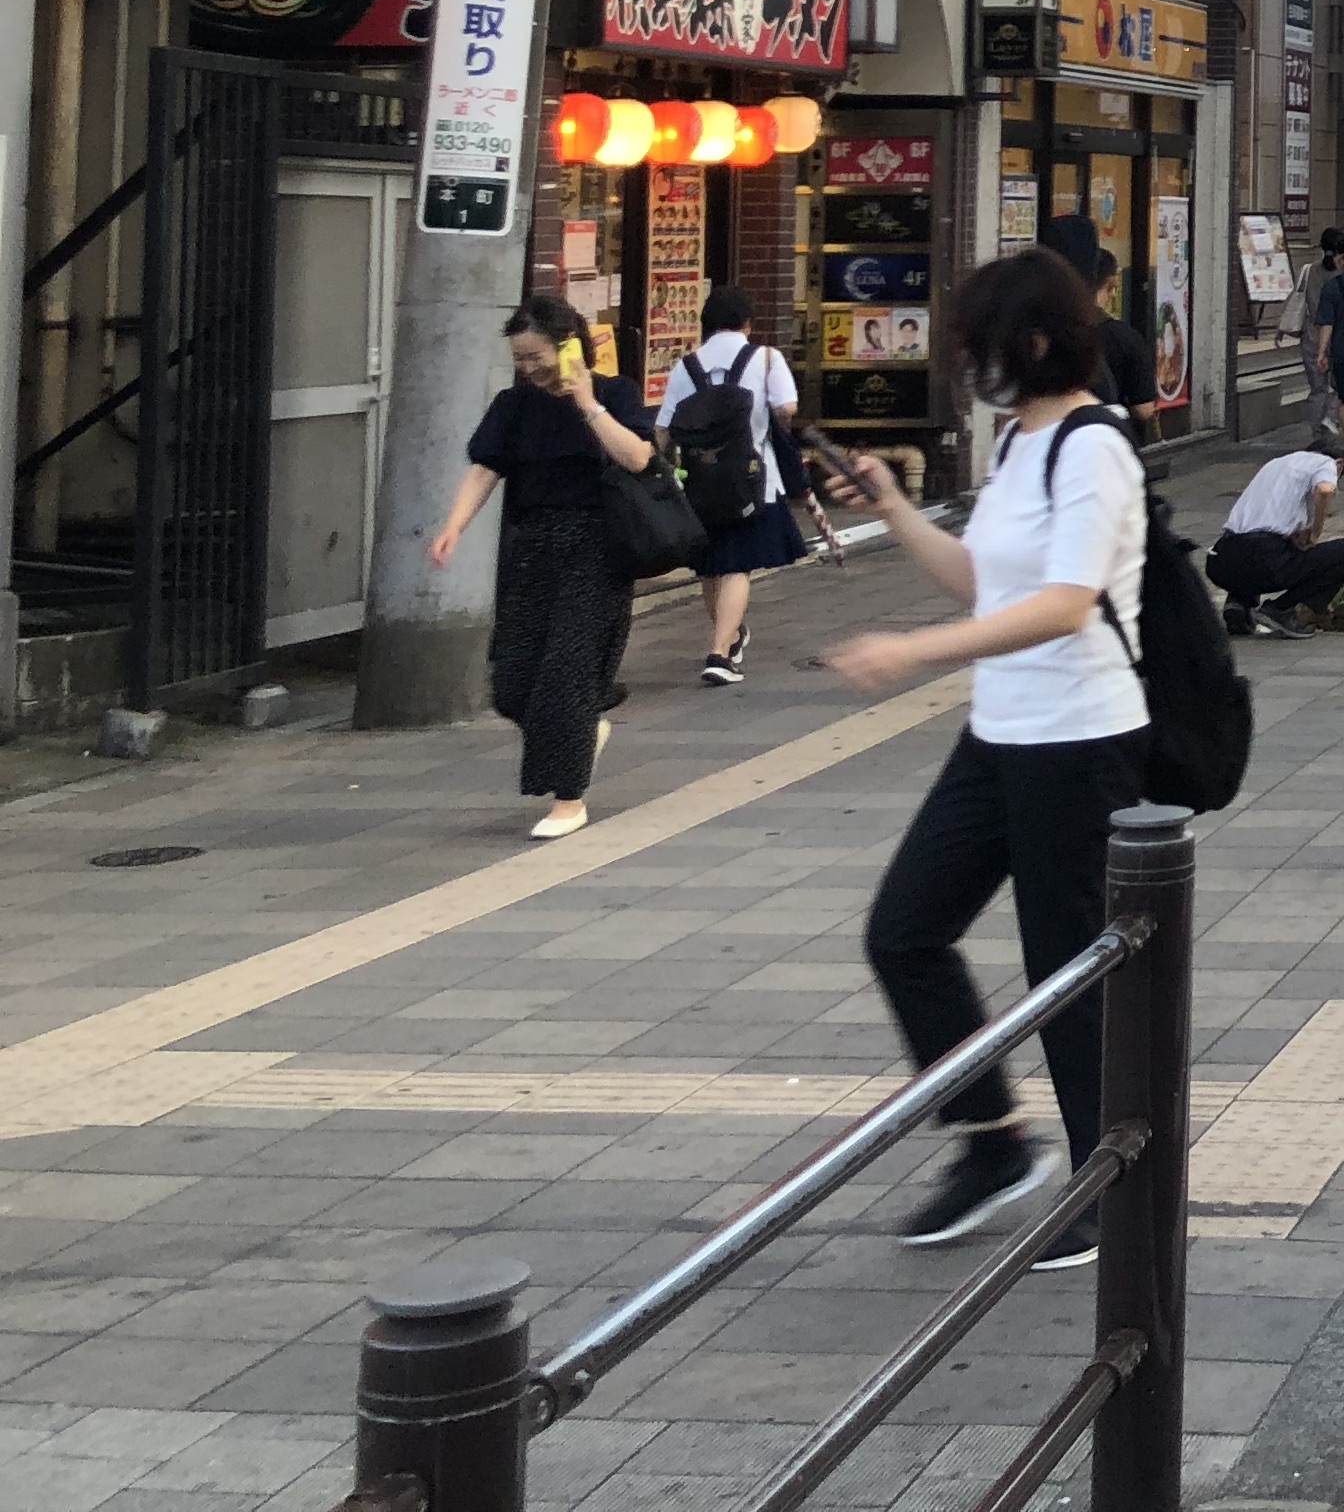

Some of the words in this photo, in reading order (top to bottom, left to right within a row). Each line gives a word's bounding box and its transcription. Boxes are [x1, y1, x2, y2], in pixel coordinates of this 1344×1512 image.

[1119, 3, 1153, 61] 松屋
[454, 102, 496, 117] 近く
[434, 134, 511, 153] 933-490
[459, 209, 467, 224] 1
[903, 271, 927, 286] 4F
